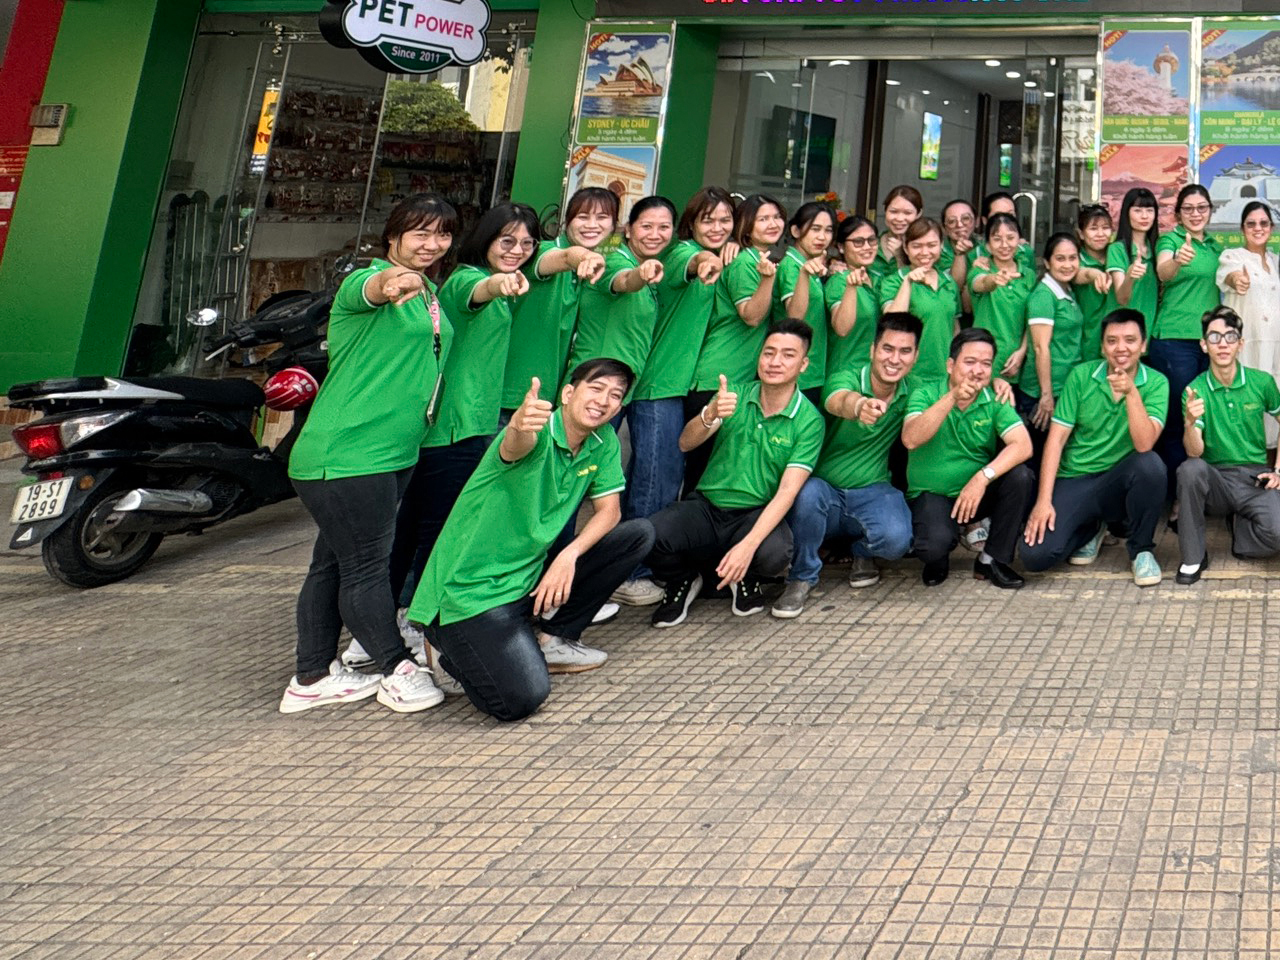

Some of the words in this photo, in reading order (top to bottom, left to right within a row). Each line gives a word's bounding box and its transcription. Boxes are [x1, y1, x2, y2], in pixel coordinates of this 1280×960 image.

[414, 13, 475, 40] POWER
[391, 45, 416, 60] Since
[419, 49, 440, 63] 2011
[27, 480, 63, 502] 19-S1
[18, 499, 57, 521] 2899
